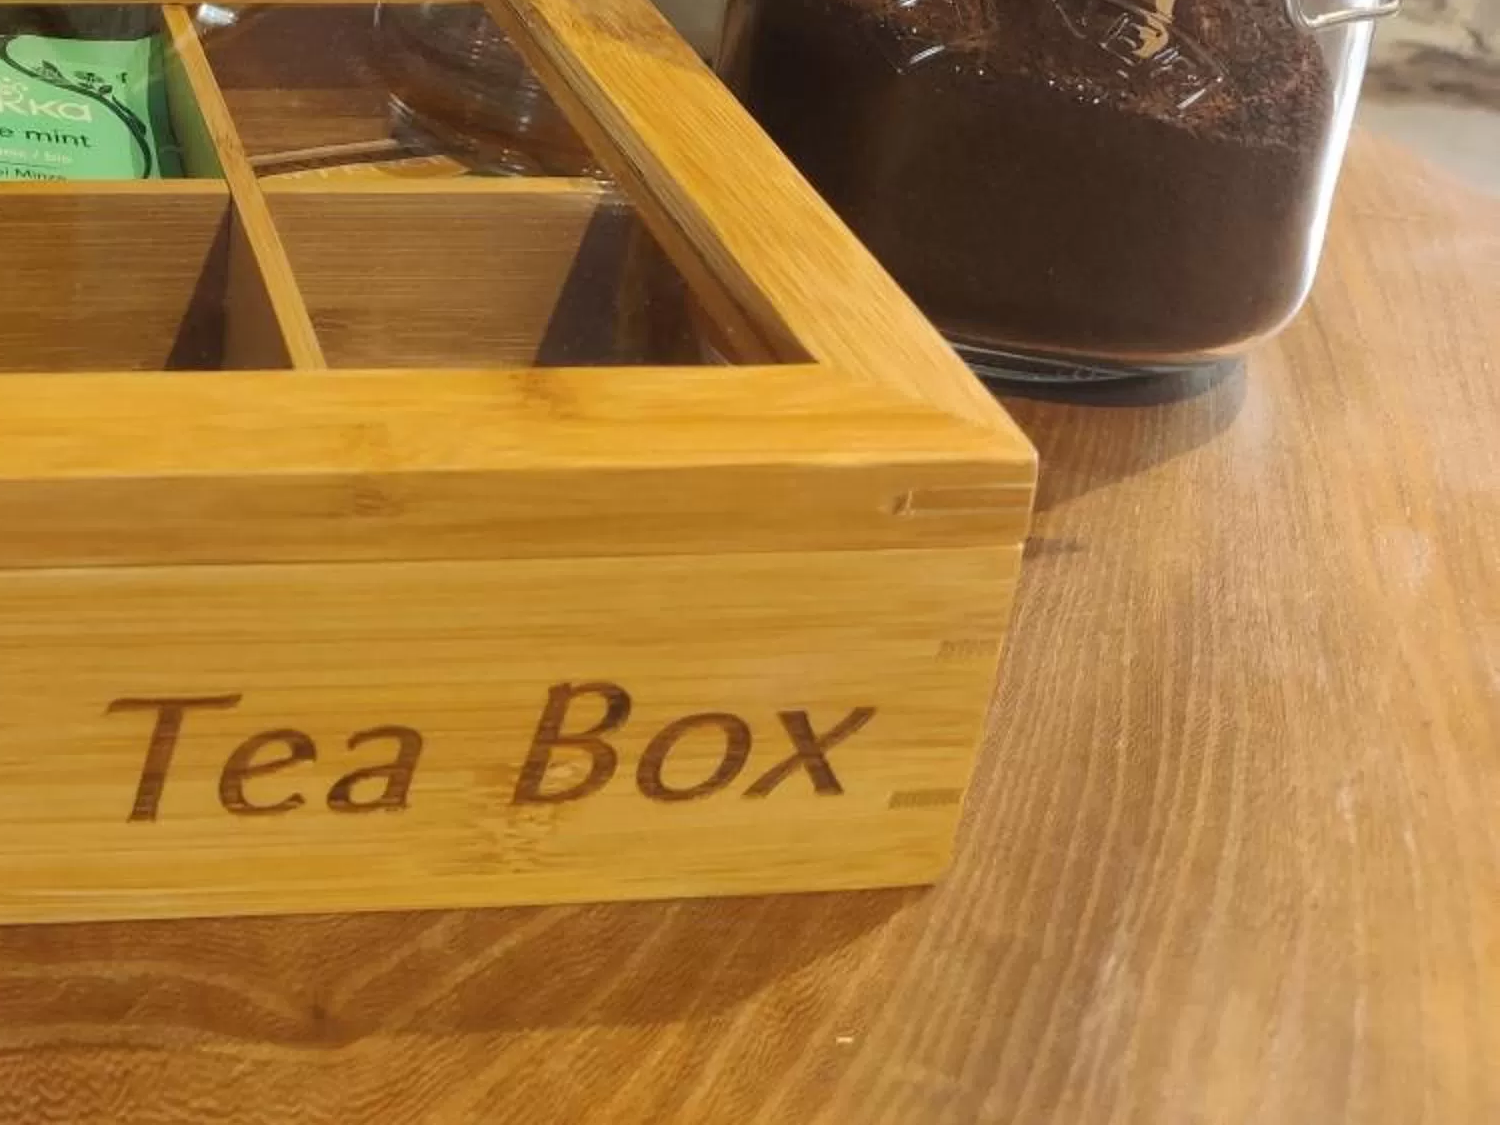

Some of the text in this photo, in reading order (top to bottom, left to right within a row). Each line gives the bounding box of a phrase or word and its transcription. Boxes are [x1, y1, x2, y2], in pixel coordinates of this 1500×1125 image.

[25, 127, 93, 149] mint
[105, 679, 879, 823] Tea Box
